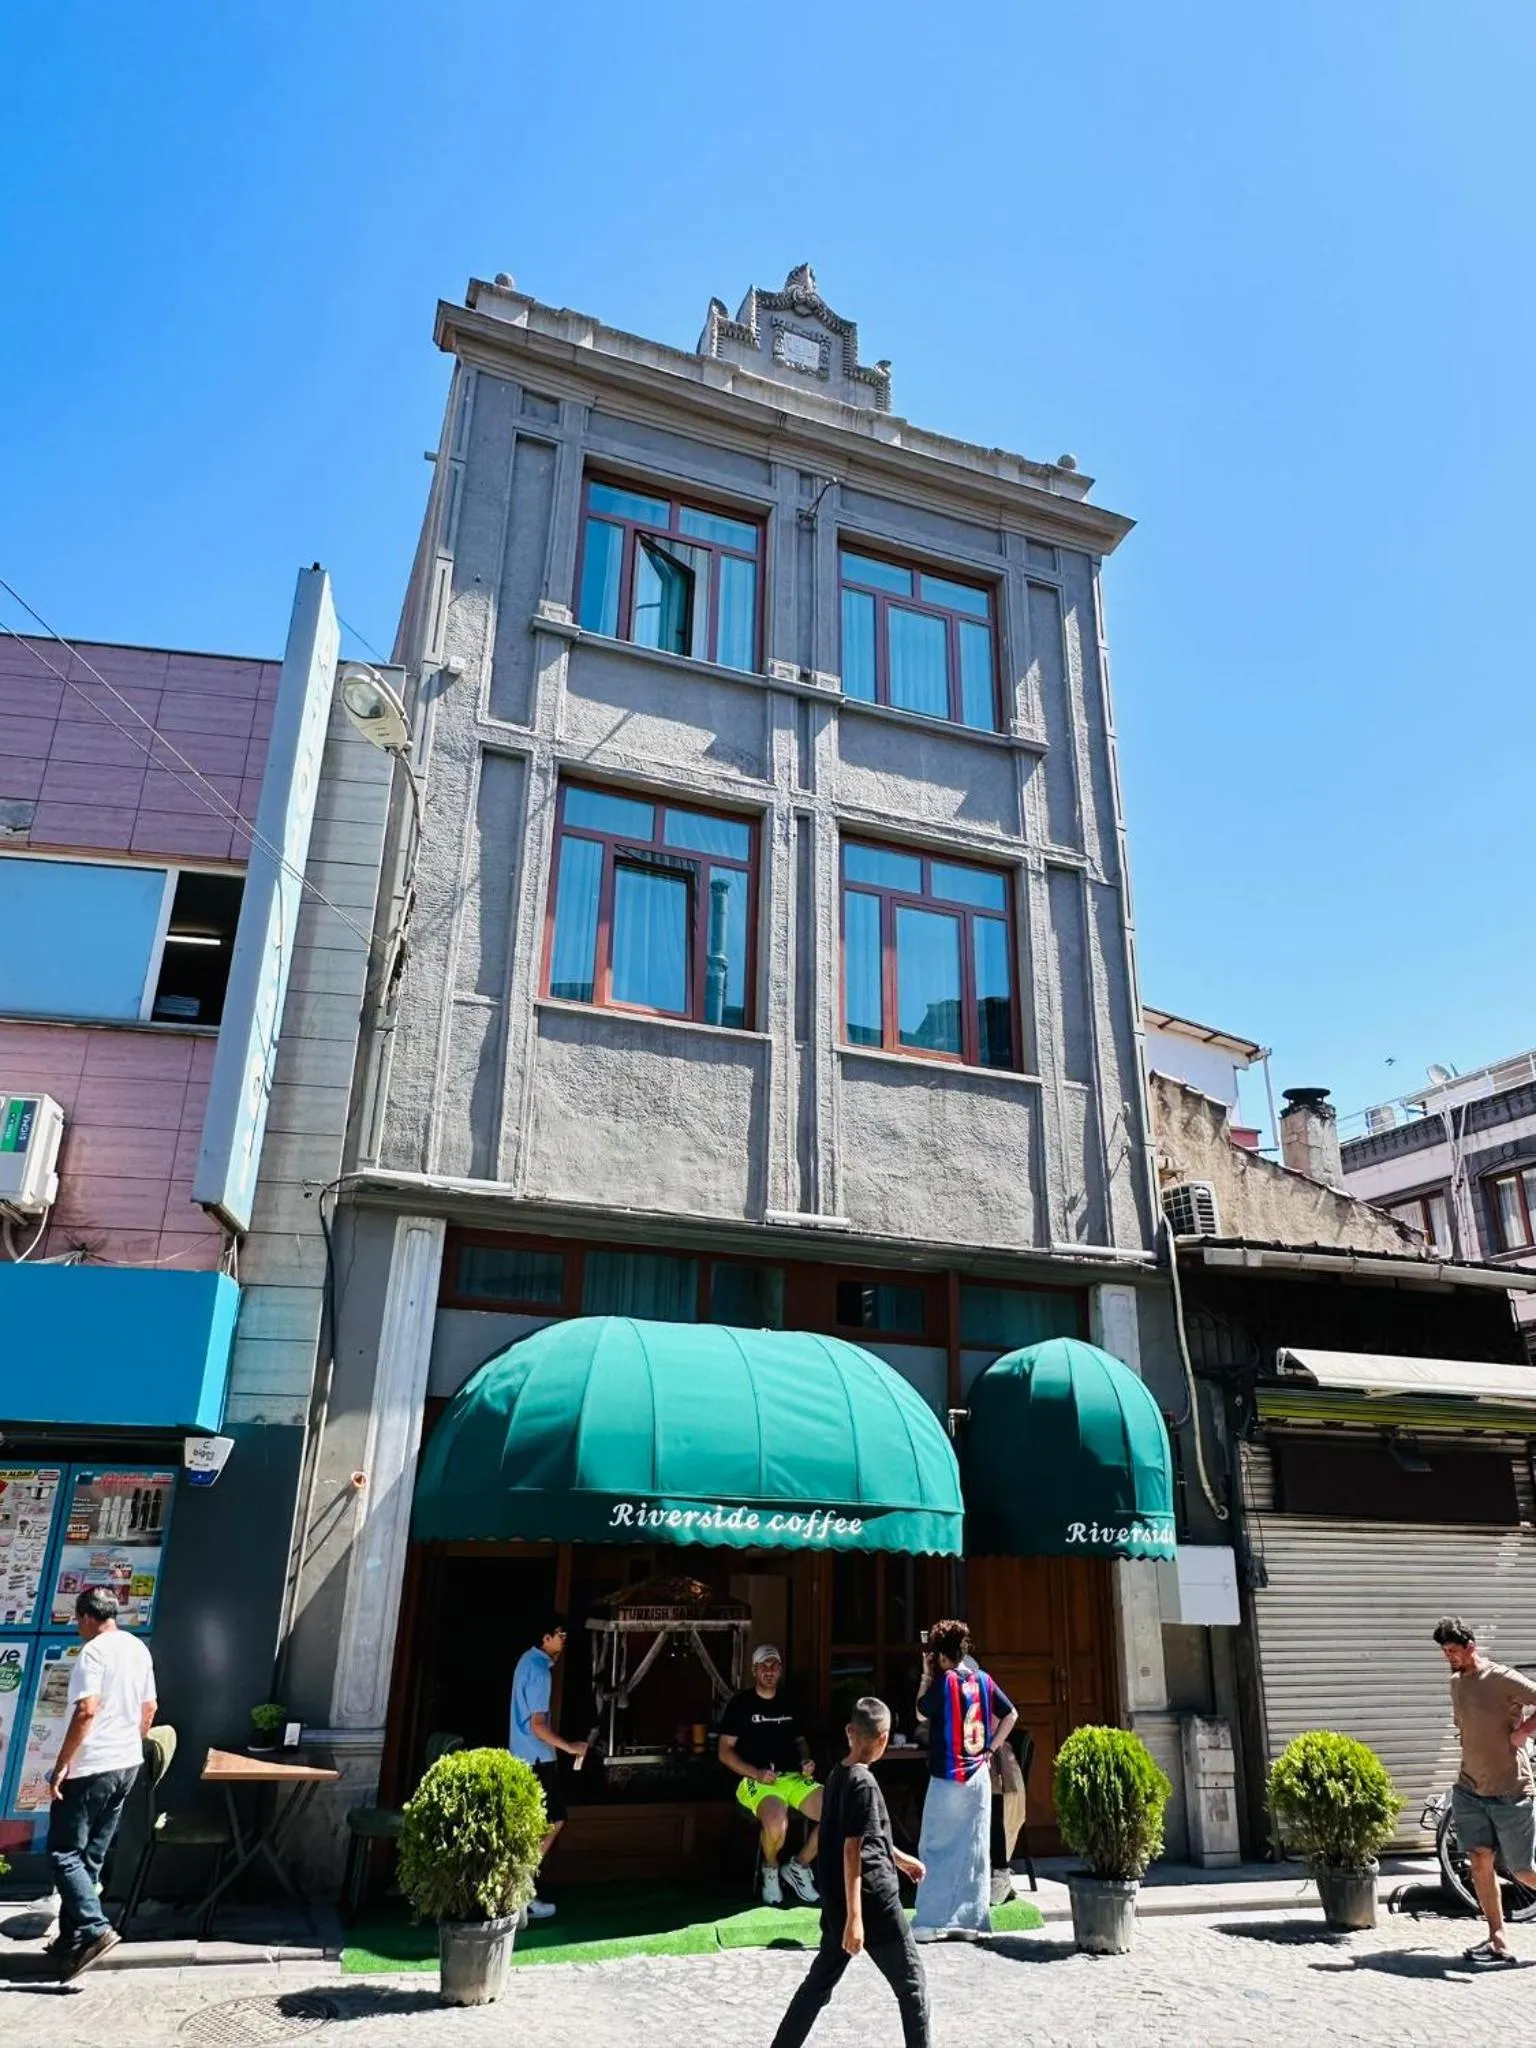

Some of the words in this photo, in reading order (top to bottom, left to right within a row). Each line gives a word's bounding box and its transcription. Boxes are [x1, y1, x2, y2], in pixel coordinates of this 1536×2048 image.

[609, 1502, 760, 1530] Riverside
[766, 1509, 863, 1539] coffee
[620, 1607, 668, 1620] TURKISH
[963, 1702, 985, 1755] 6
